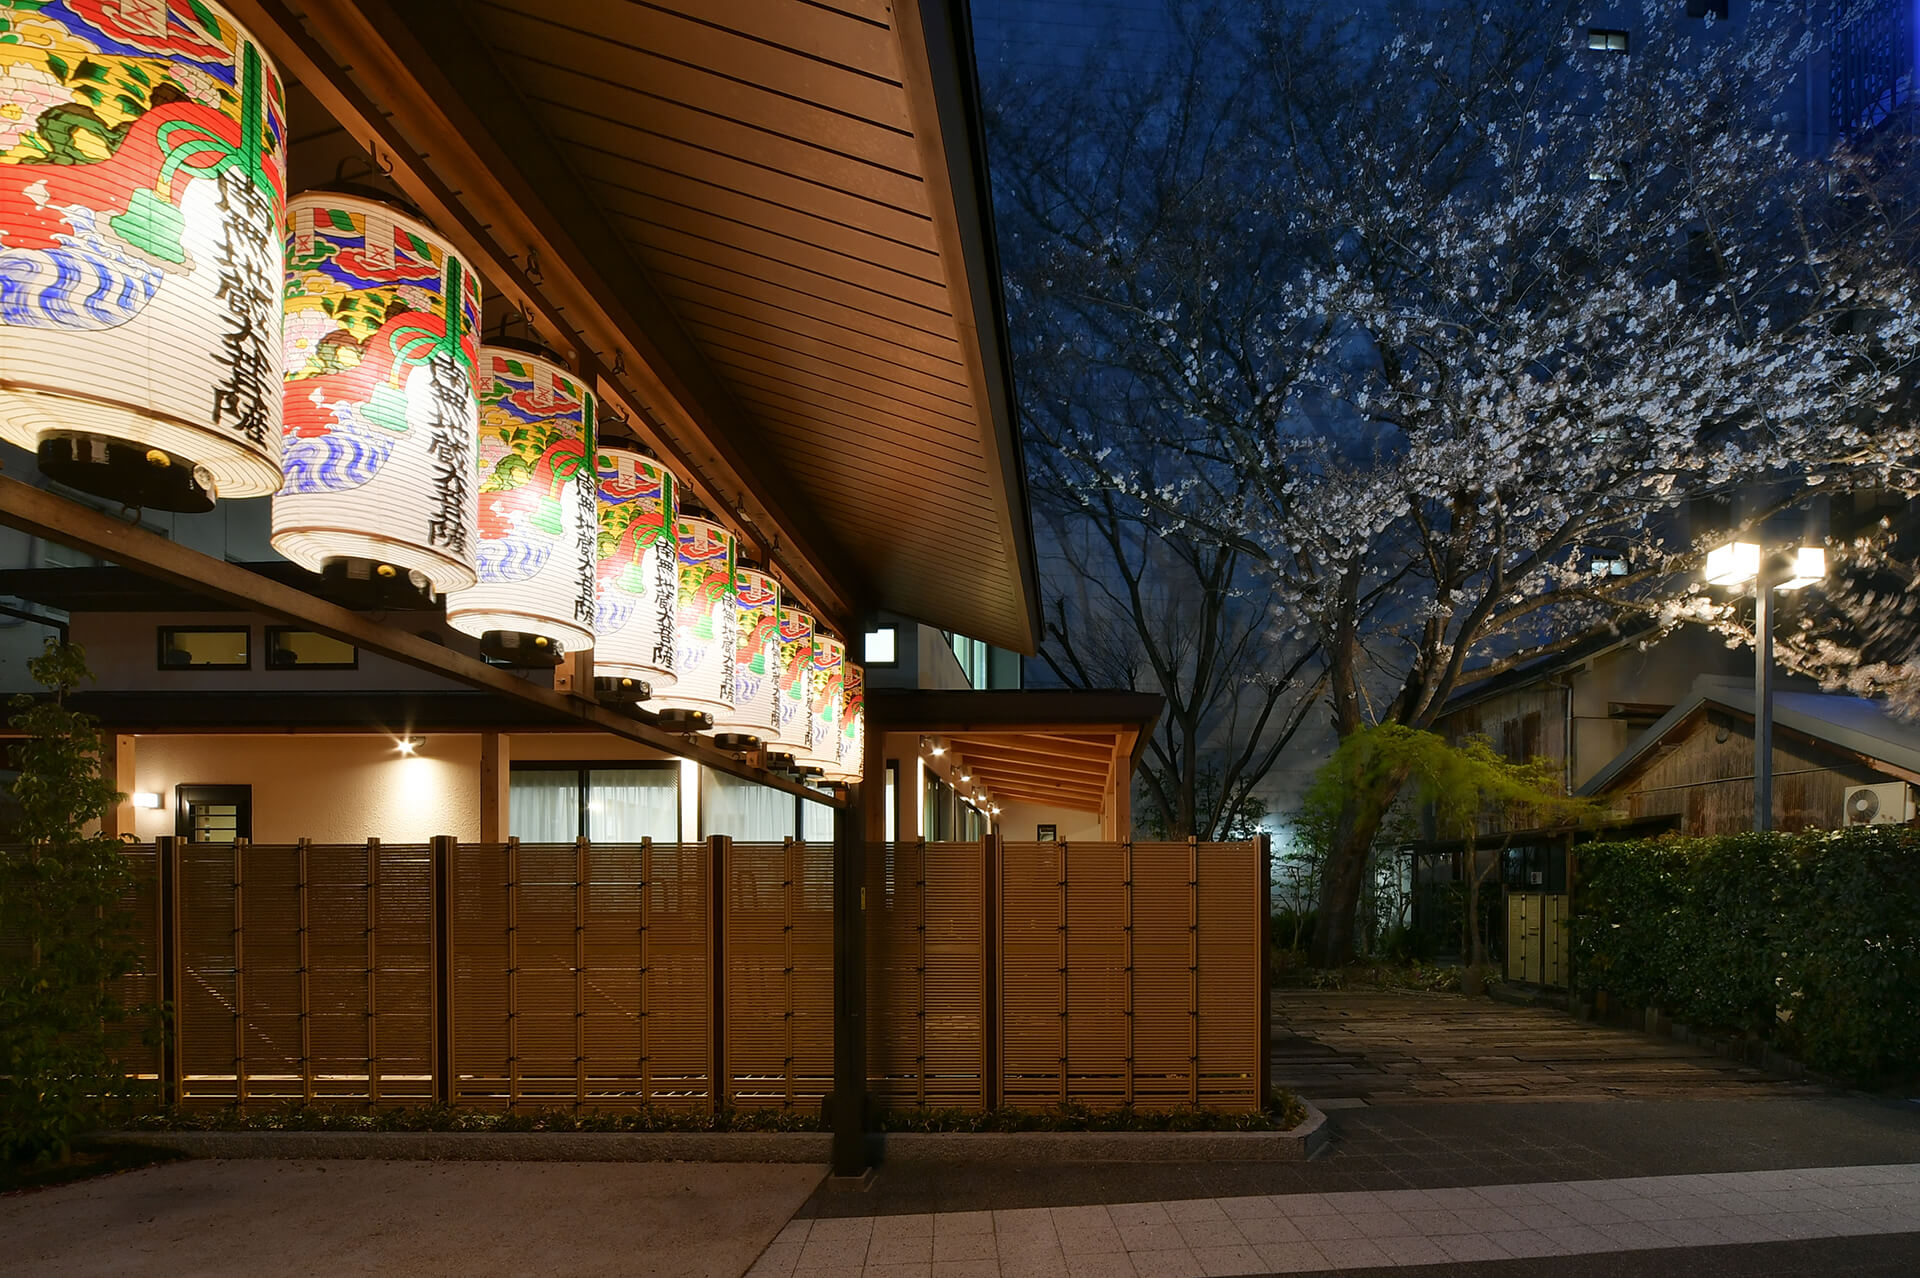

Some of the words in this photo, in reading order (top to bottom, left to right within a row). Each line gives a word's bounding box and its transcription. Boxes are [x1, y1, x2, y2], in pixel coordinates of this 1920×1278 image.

[210, 168, 272, 450] 南無地蔵大菩薩
